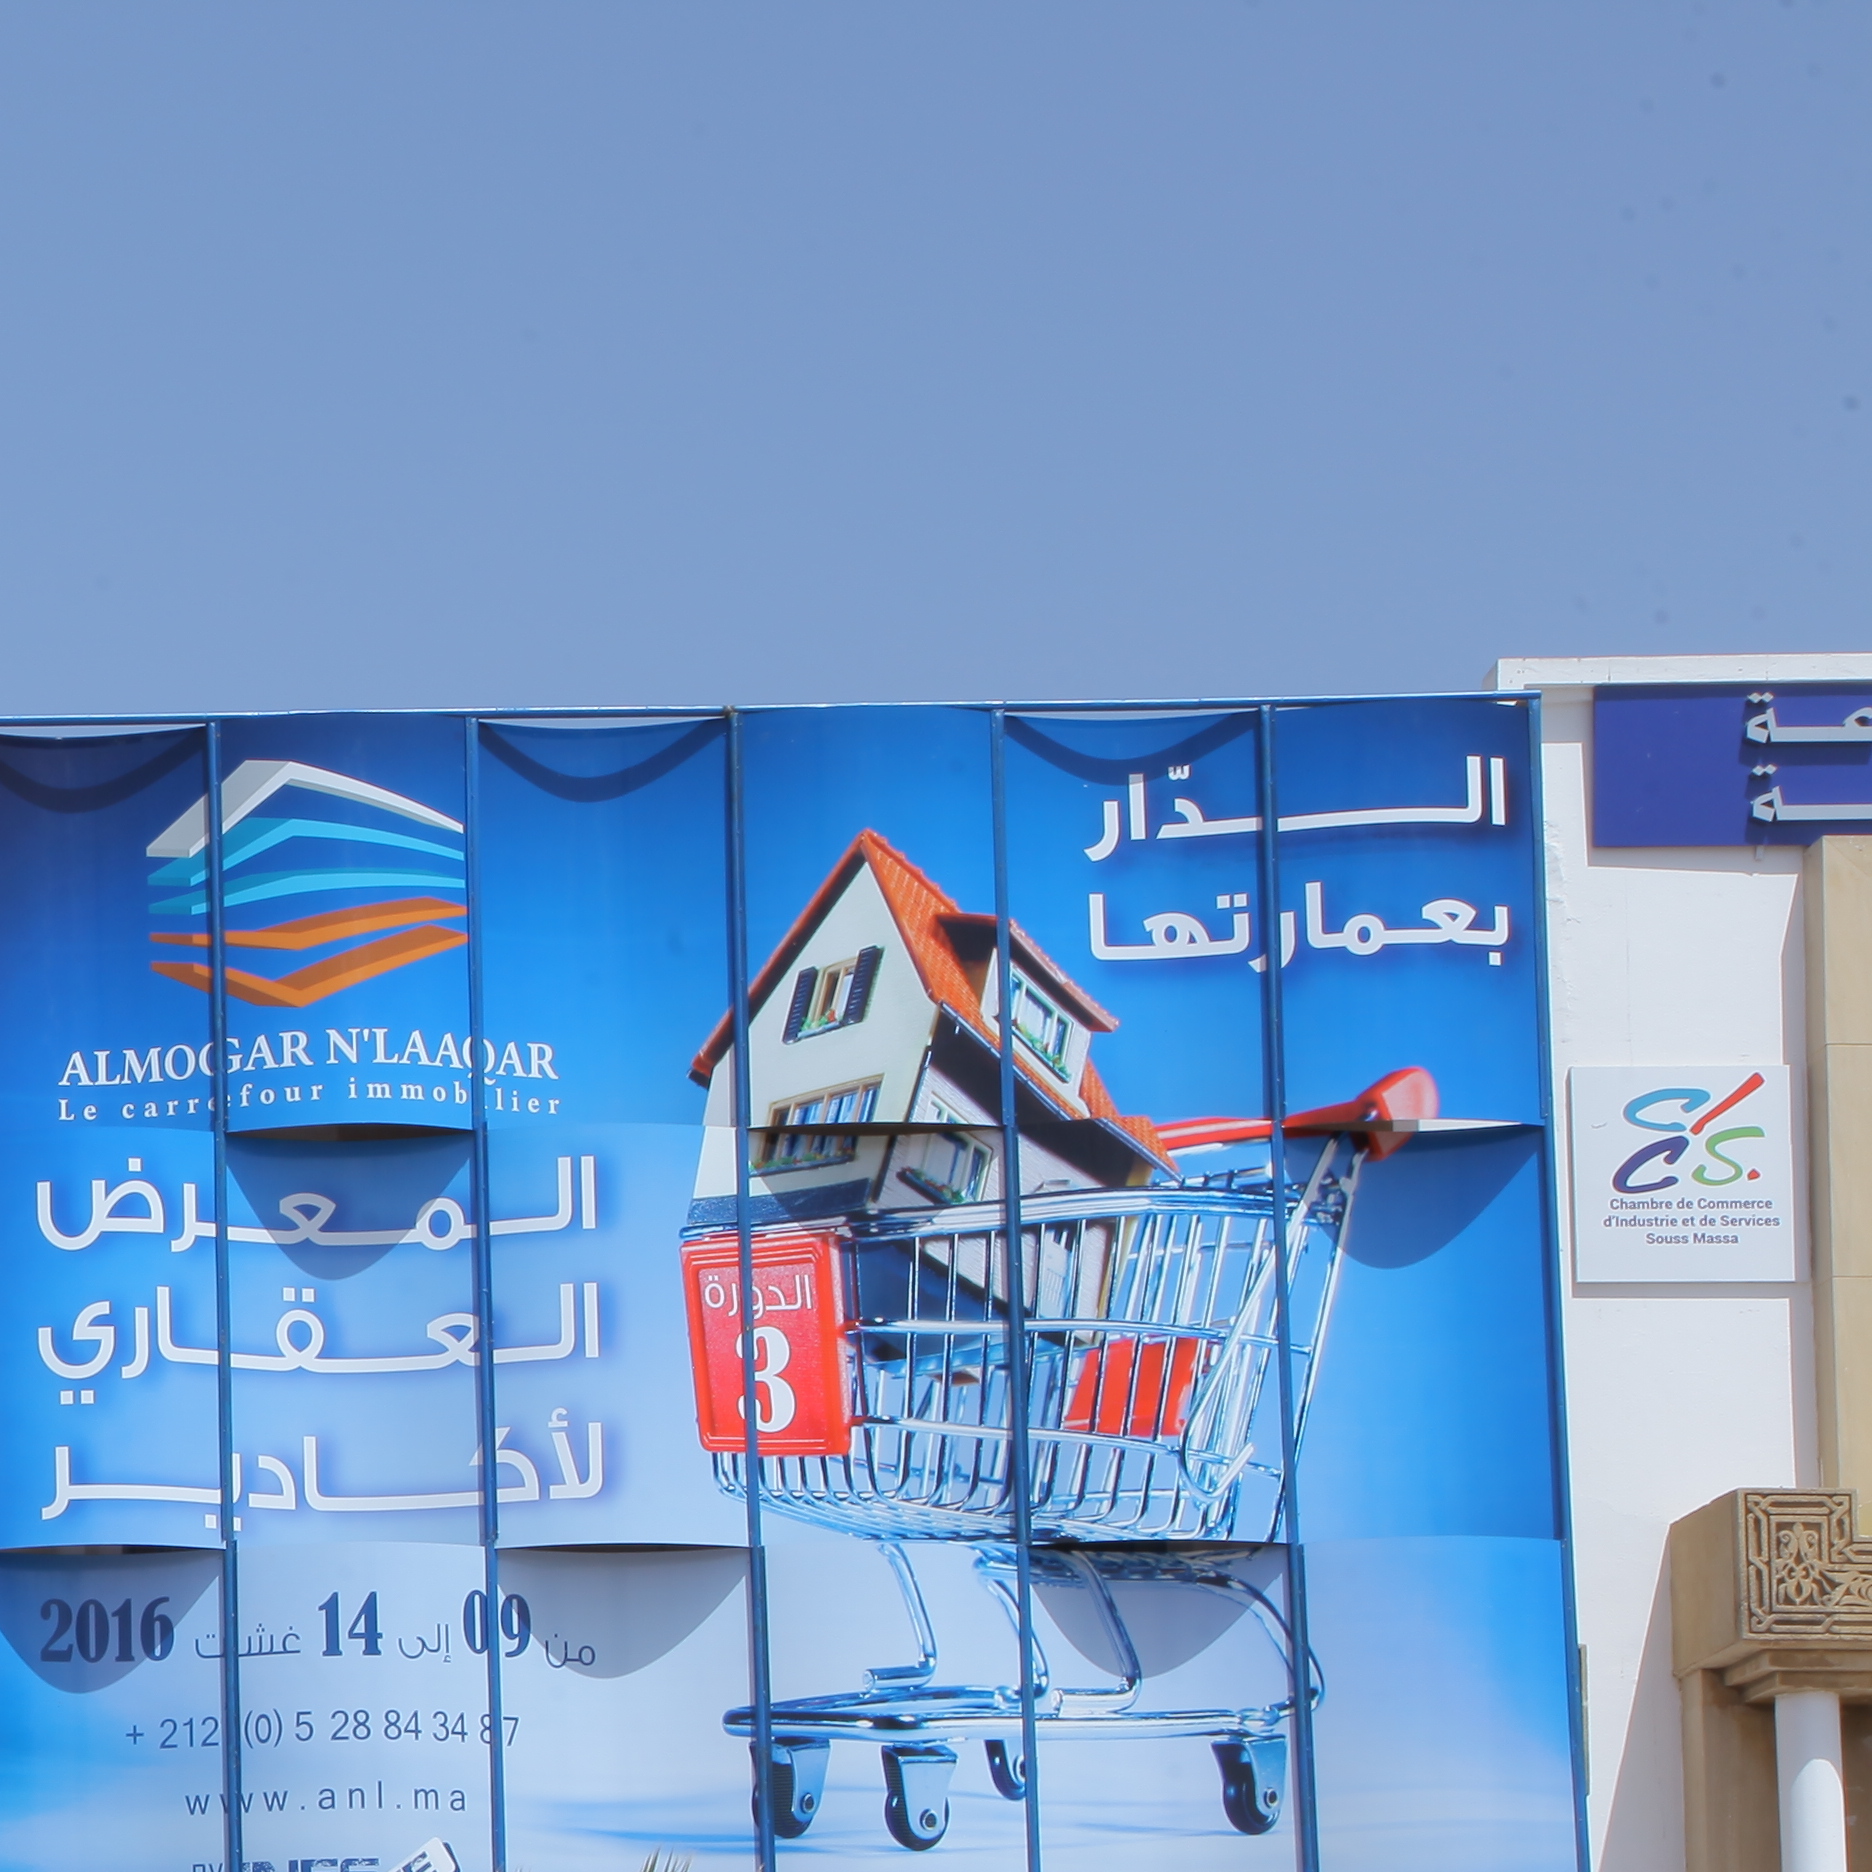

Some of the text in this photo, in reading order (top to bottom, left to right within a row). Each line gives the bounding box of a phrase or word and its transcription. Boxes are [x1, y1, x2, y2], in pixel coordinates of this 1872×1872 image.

[1088, 881, 1511, 972] بعمارتها
[59, 1027, 559, 1087] ALMOGAR N'LAAQAR
[58, 1098, 98, 1121] Le
[348, 1077, 561, 1115] immoblier
[36, 1156, 596, 1252] المعرض
[1603, 1215, 1781, 1227] d'Industrie et de Services
[1609, 1198, 1773, 1210] Chambre de Commerce
[1645, 1233, 1739, 1245] Souss Massa
[38, 1282, 600, 1405] العقاري
[736, 1326, 797, 1433] 3
[41, 1408, 604, 1531] لأكادير
[39, 1589, 596, 1670] من 09 إلى 14 غشت 2016
[159, 1708, 520, 1749] 212 (0) 5 28 84 34 87
